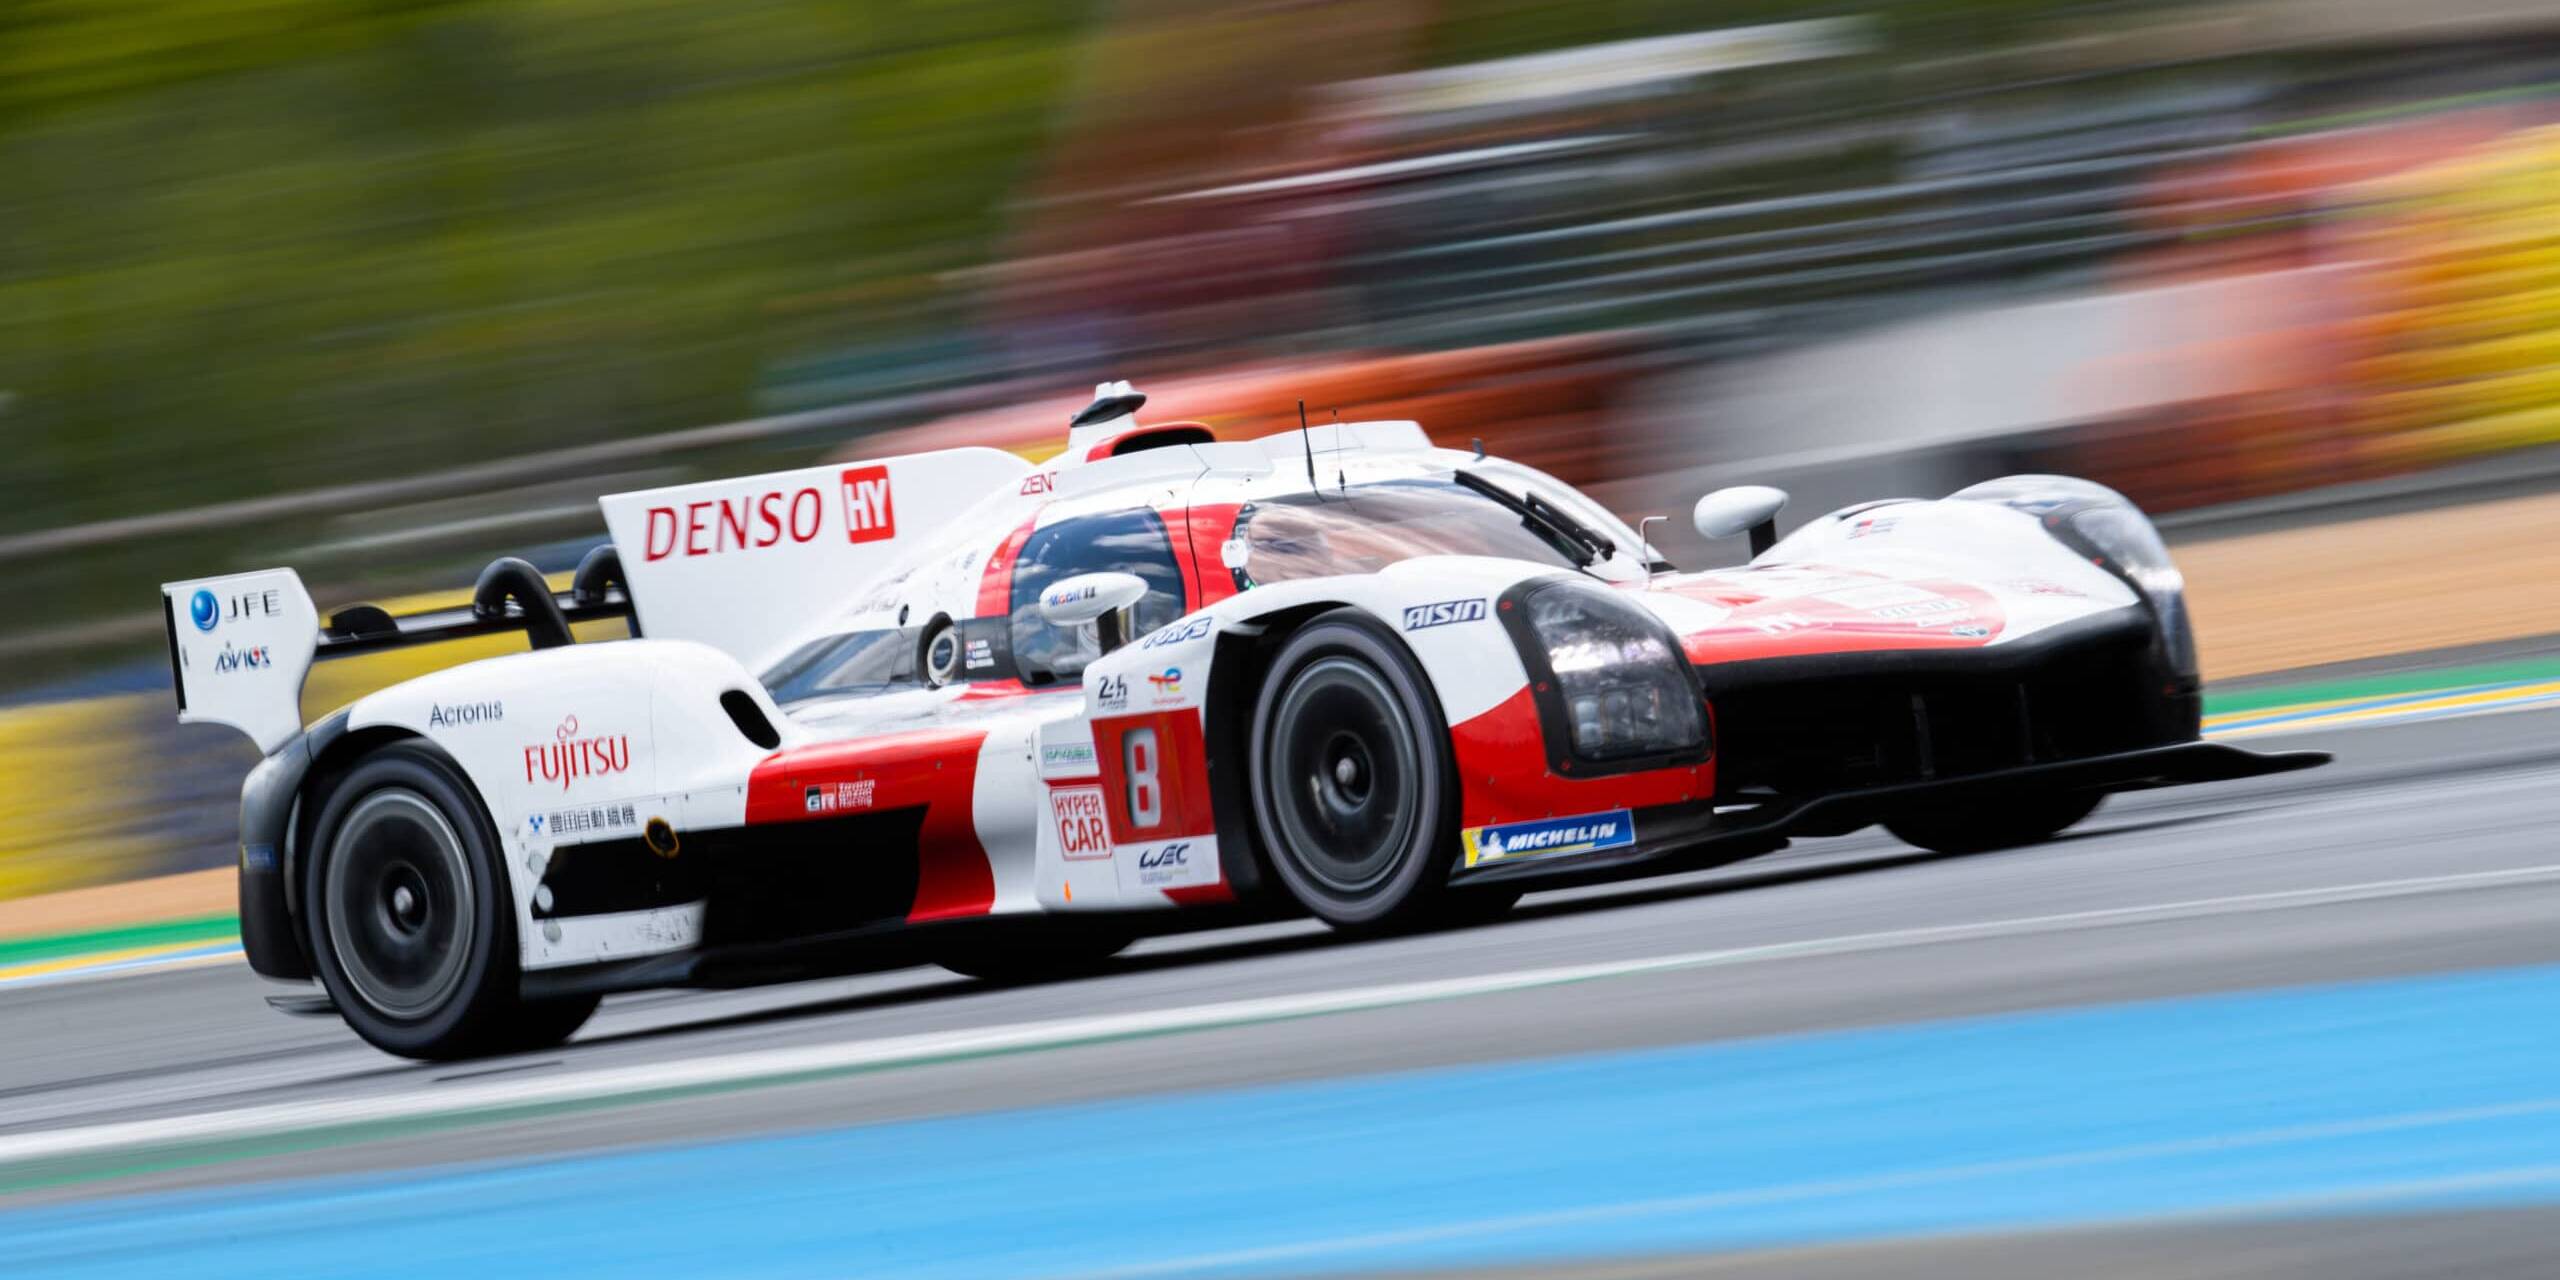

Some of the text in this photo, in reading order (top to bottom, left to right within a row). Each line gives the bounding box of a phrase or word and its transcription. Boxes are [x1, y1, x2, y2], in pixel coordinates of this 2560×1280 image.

[643, 478, 888, 562] DENSO HY
[225, 589, 281, 622] JFE
[1405, 600, 1485, 631] AISIN
[429, 701, 503, 729] Acronis
[524, 734, 630, 792] FUJITSU
[1123, 727, 1162, 828] 8
[807, 792, 835, 812] GR
[1055, 793, 1101, 817] HYPER
[1061, 816, 1107, 853] CAR
[1507, 822, 1617, 850] MICHELIN
[1139, 844, 1190, 869] WEC
